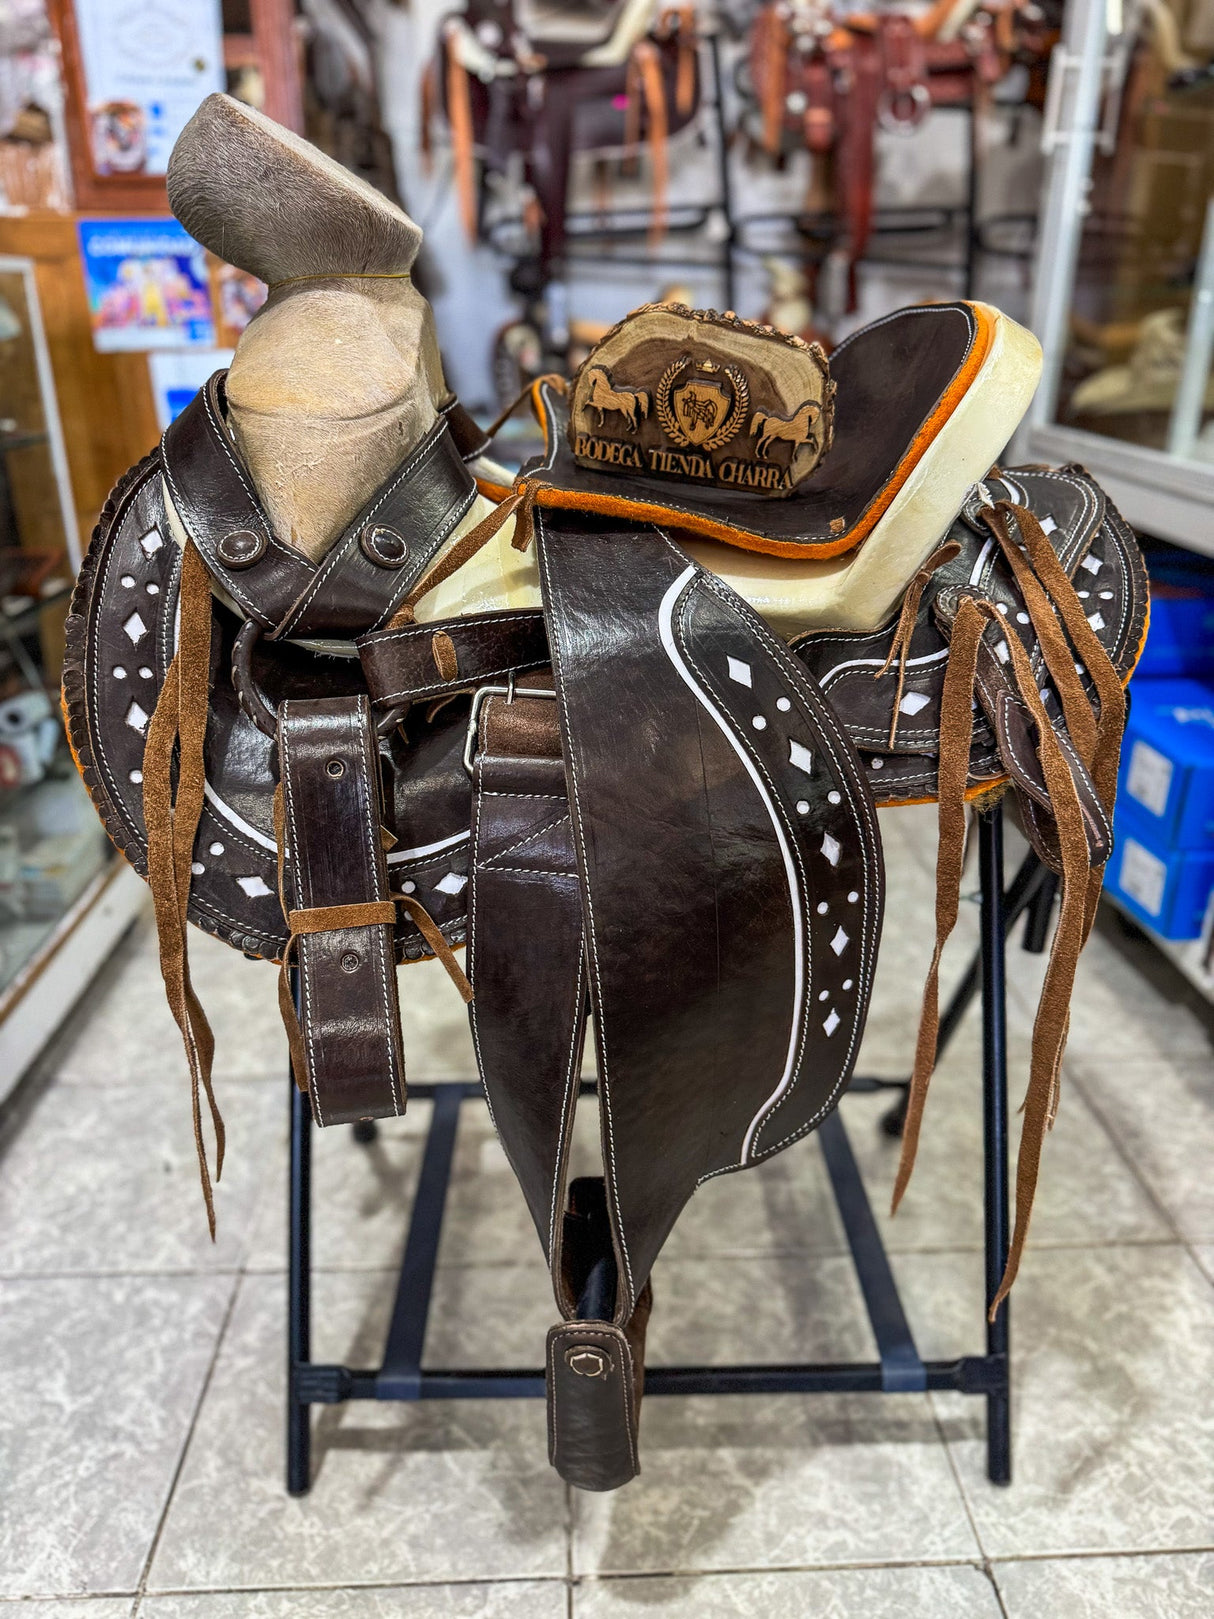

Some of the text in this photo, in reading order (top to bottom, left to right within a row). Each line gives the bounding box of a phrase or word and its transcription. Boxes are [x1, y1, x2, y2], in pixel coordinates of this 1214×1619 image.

[575, 436, 793, 489] BODEGA TIENDA CHARRA
